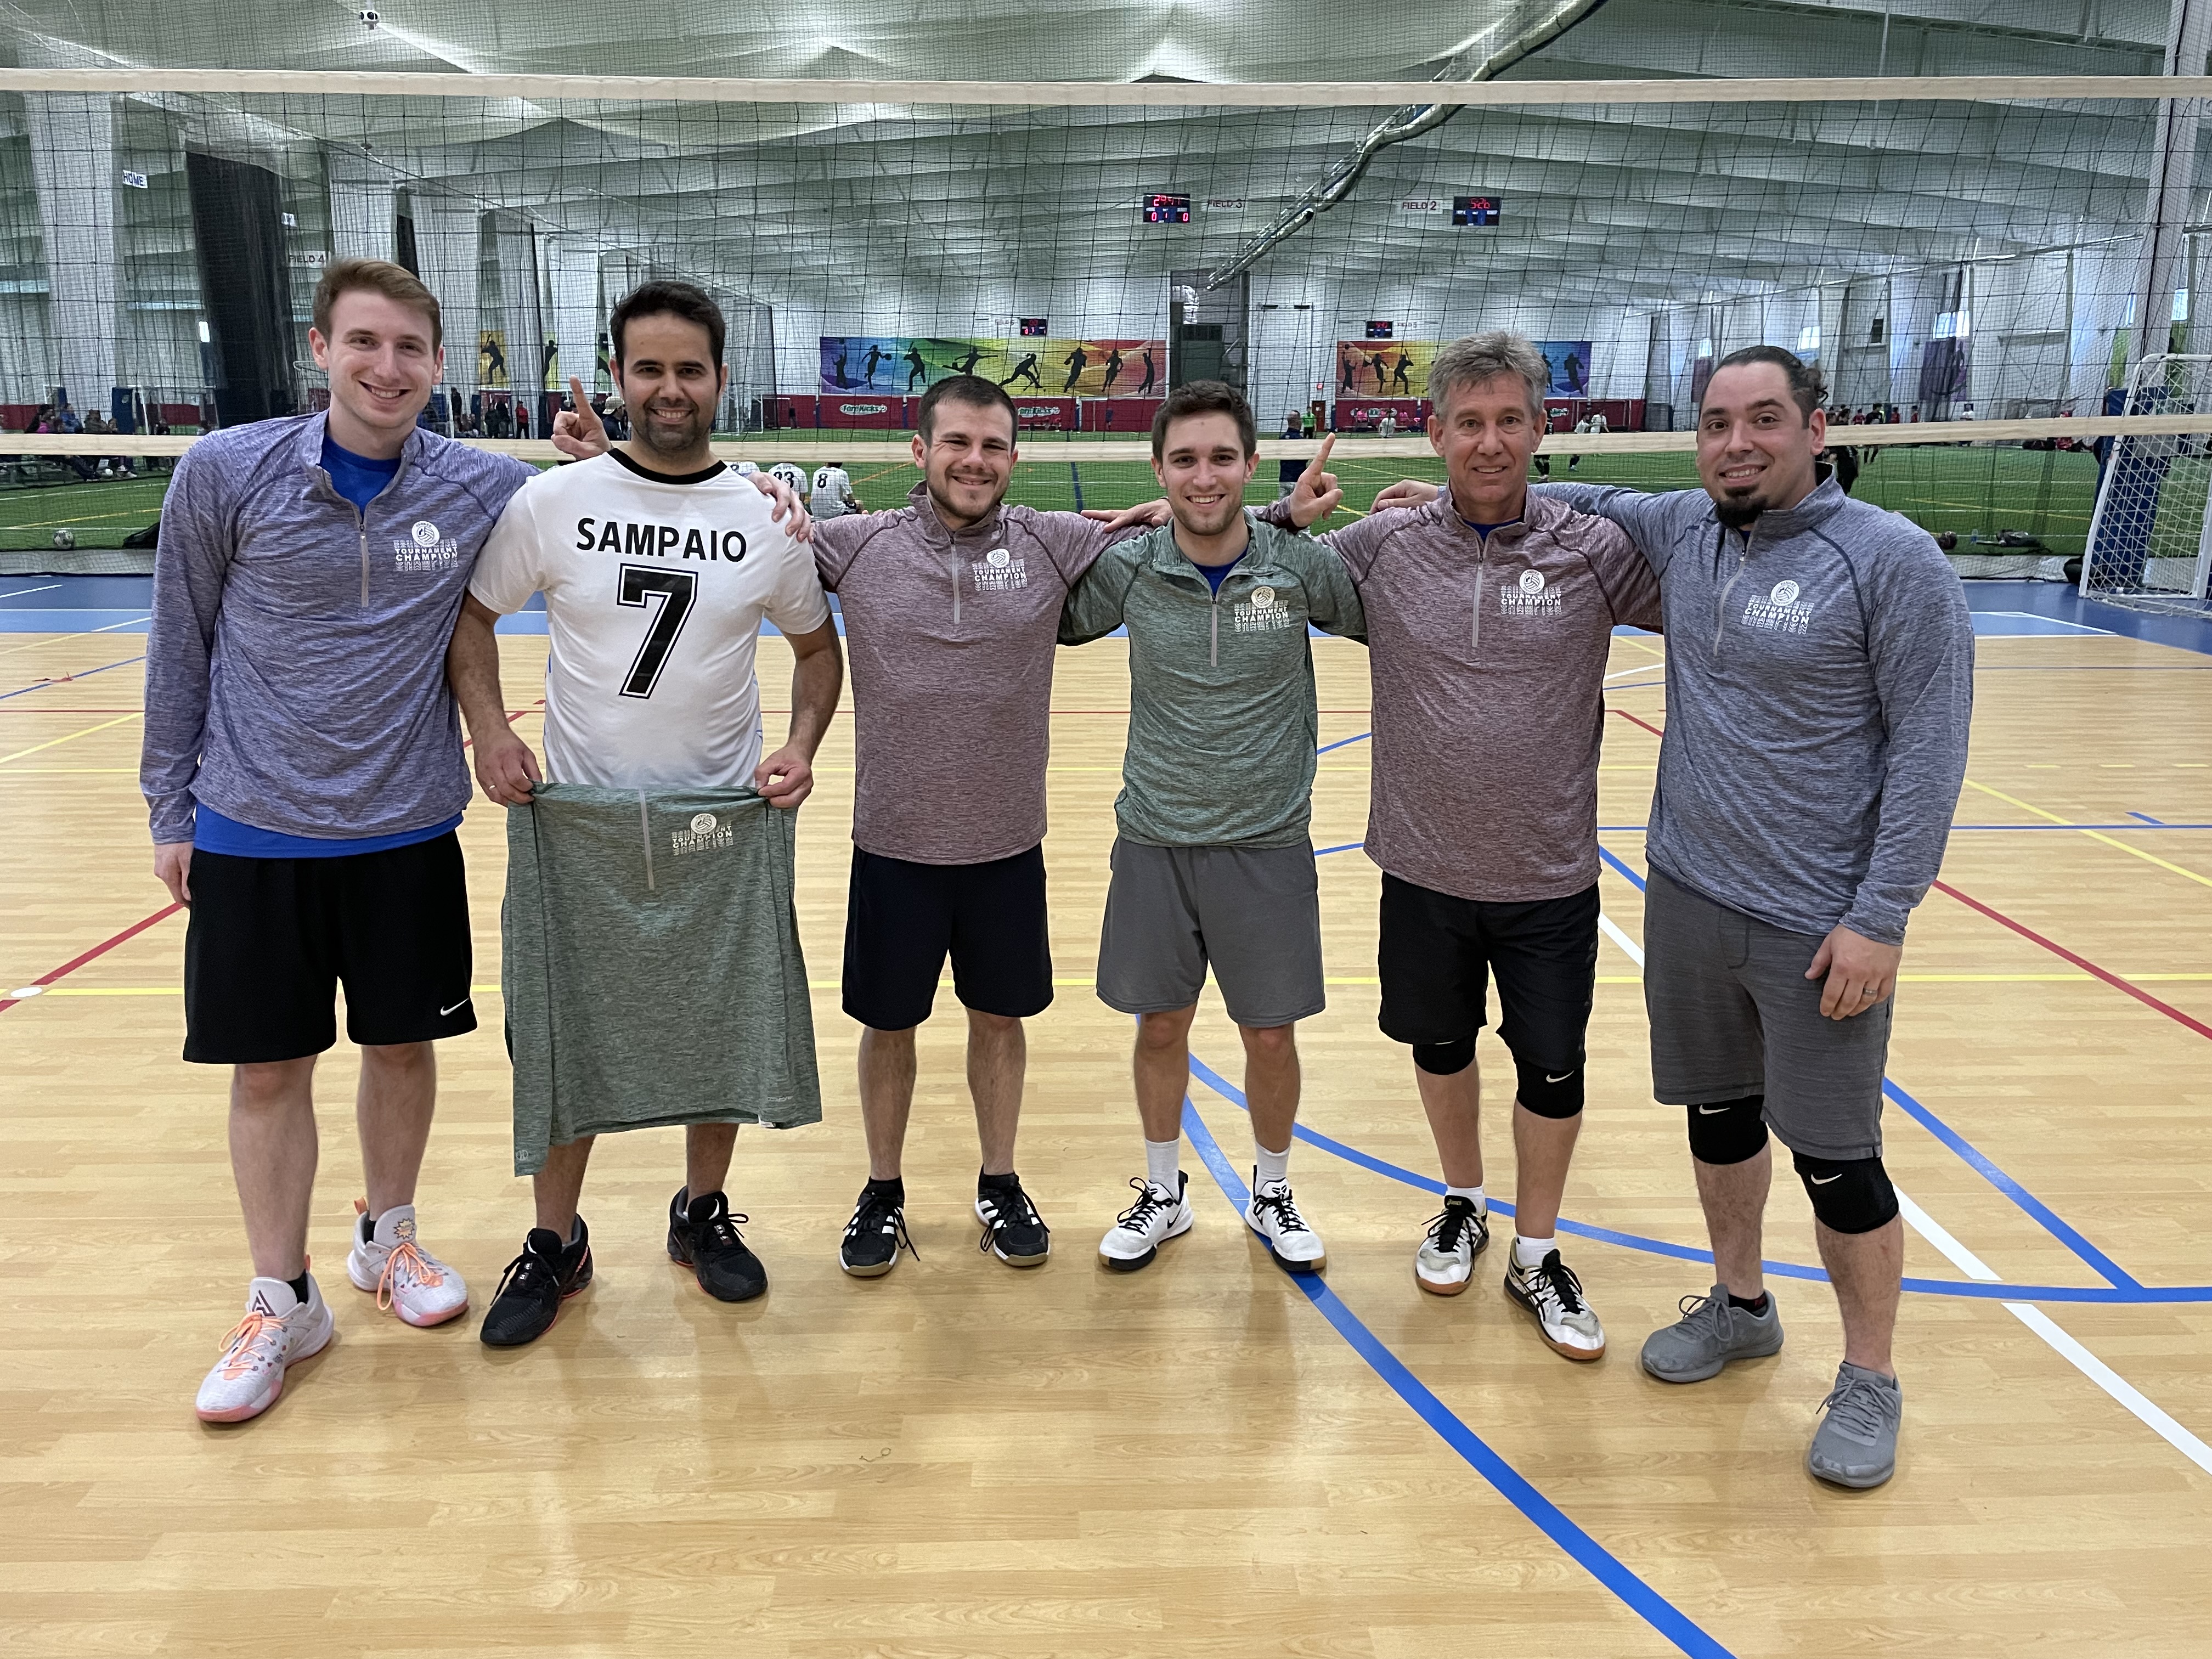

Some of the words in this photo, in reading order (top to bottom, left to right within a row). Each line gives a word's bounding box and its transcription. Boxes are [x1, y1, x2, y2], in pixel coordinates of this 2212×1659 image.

[123, 172, 144, 187] HOME
[1236, 198, 1243, 208] 3
[1430, 201, 1437, 211] 2
[1152, 212, 1157, 221] 0
[1183, 212, 1189, 222] 0
[289, 255, 315, 263] FIELD
[318, 254, 325, 263] 4
[817, 473, 828, 488] 8
[576, 517, 747, 562] SAMPAIO
[394, 546, 458, 555] TOURNAMENT
[396, 552, 458, 562] CHAMPION
[973, 566, 1025, 575] TOURNAMENT
[974, 572, 1027, 582] CHAMPION
[1234, 607, 1287, 617] TOURNAMENT
[1748, 602, 1812, 617] TOURNAMENT
[1234, 612, 1288, 623] CHAMPION
[1745, 608, 1809, 624] CHAMPION
[617, 562, 698, 699] 7
